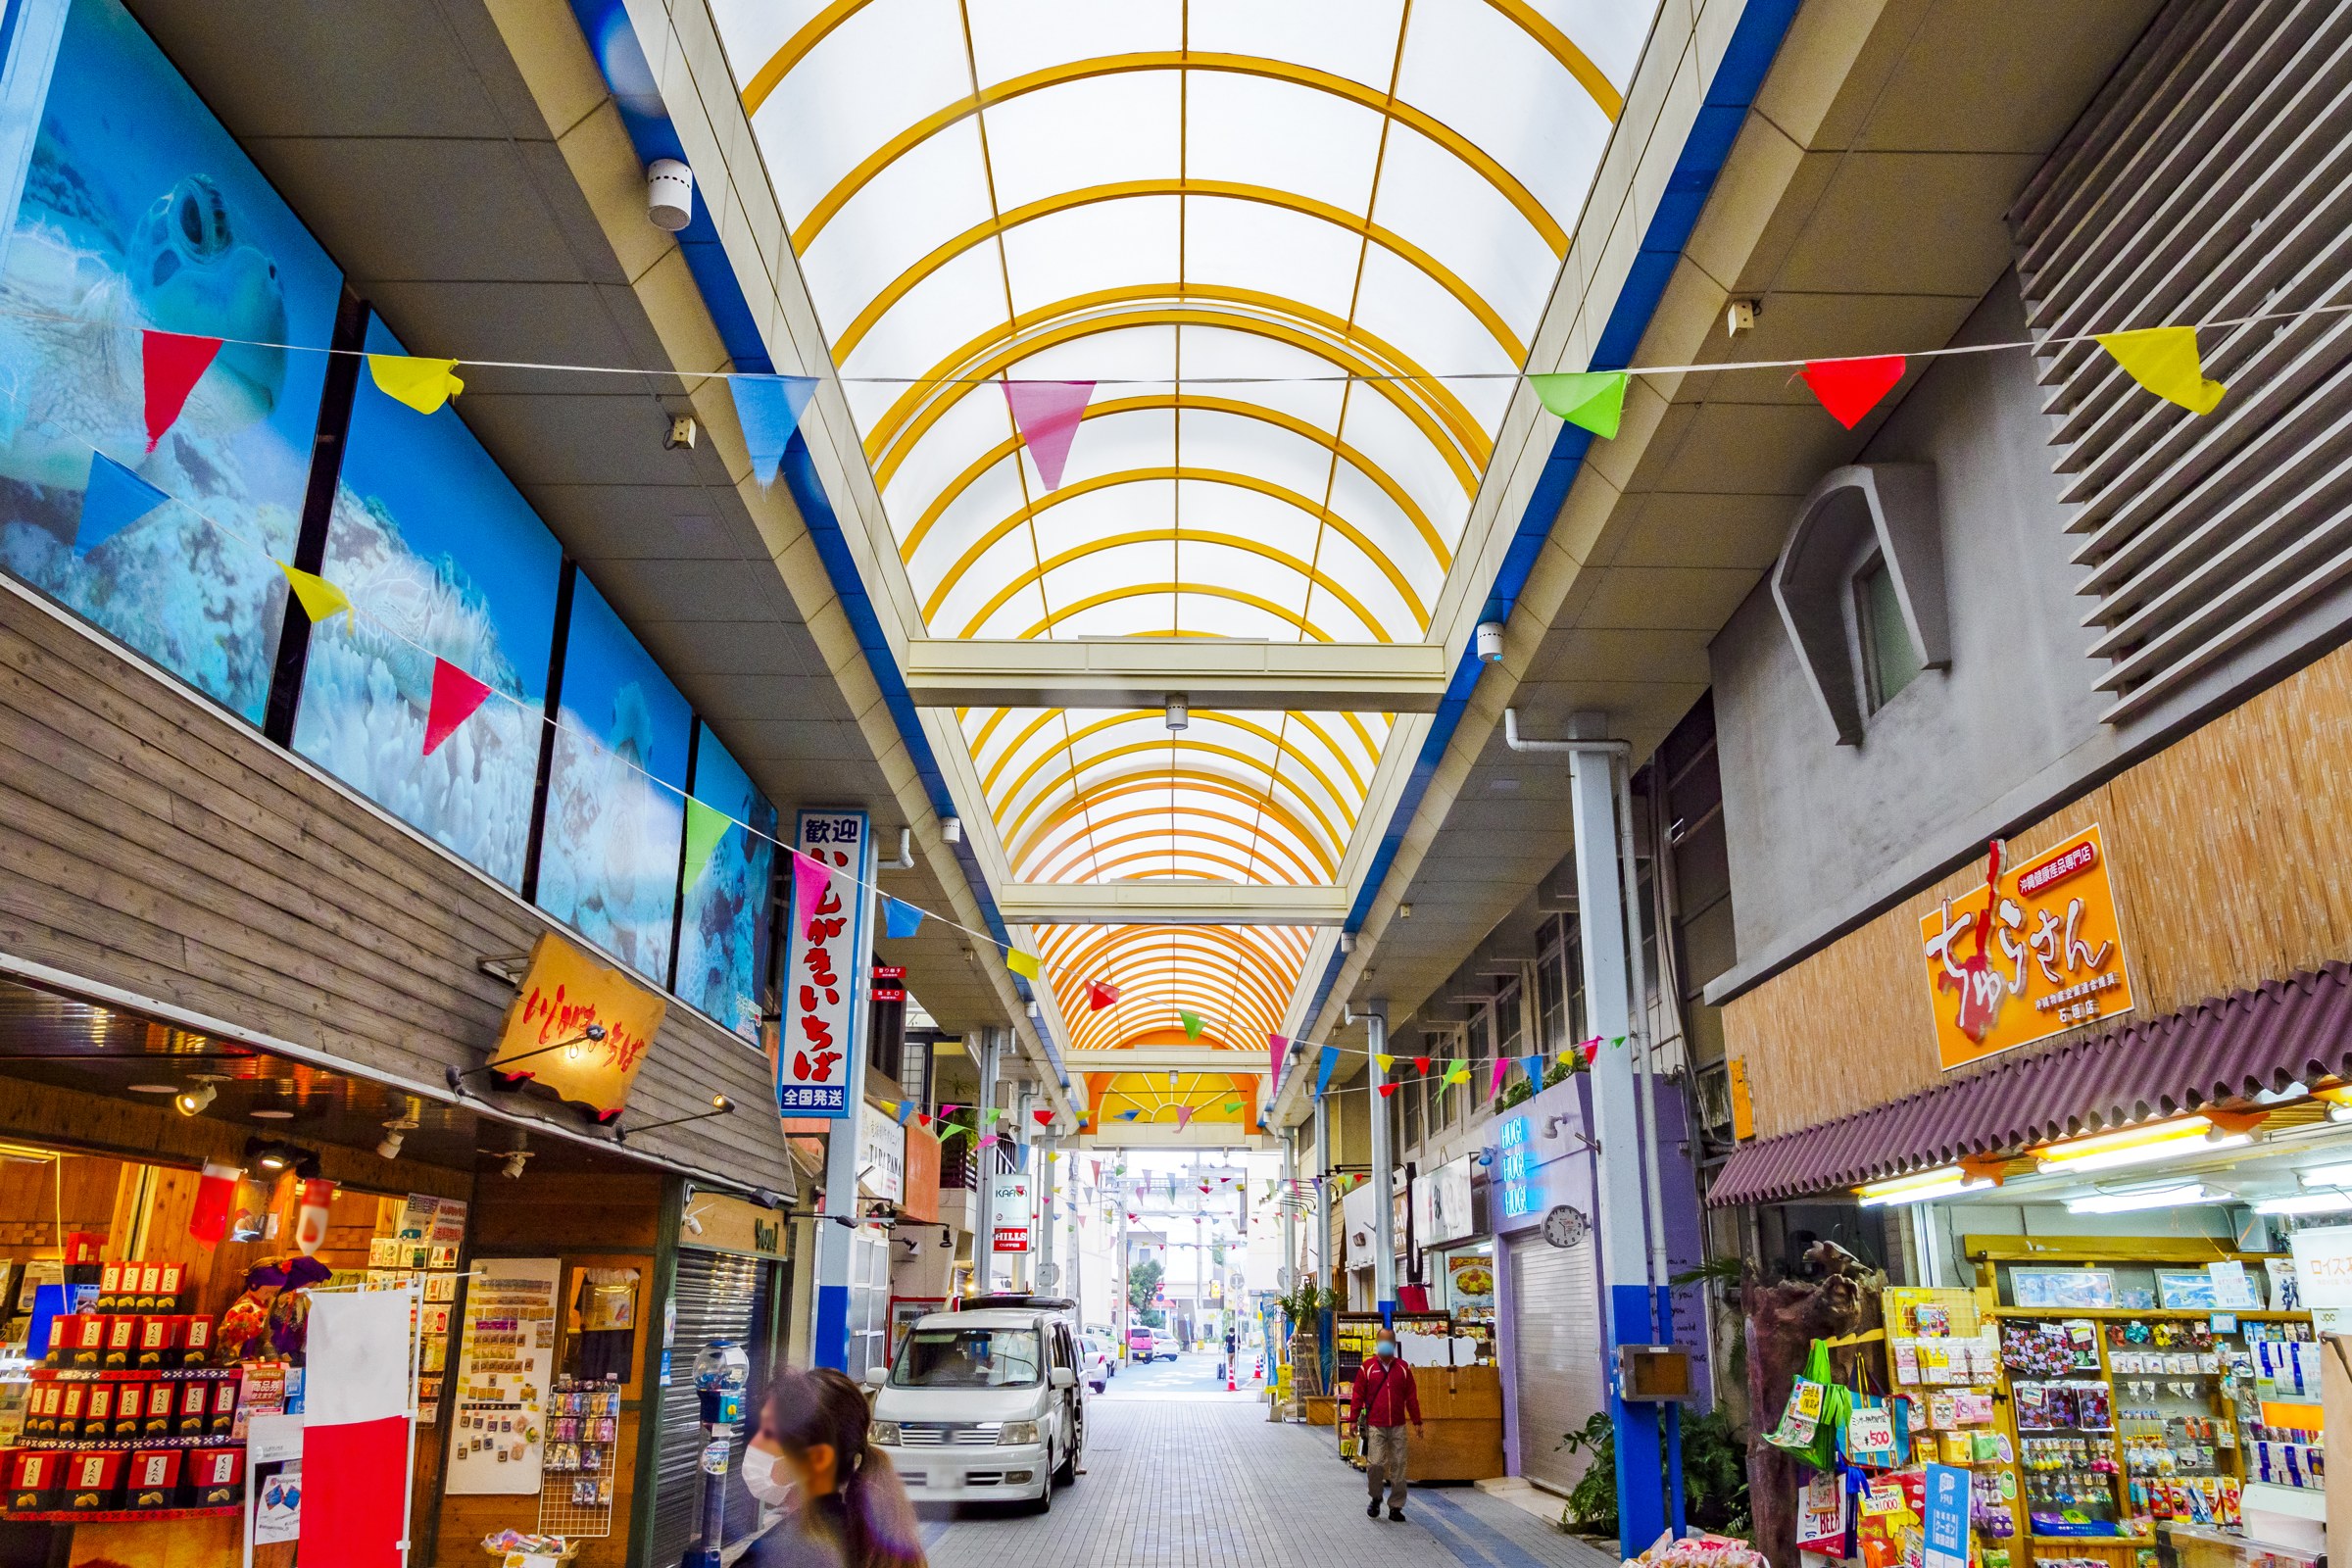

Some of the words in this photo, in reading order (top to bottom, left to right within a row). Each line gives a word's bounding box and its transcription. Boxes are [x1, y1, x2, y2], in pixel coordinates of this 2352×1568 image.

[806, 819, 858, 844] 歓迎
[1926, 898, 2109, 1027] ちゅらさん
[783, 1089, 843, 1110] 全国発送
[995, 1232, 1027, 1241] HILLS
[252, 1380, 280, 1393] 商品券
[1864, 1430, 1889, 1446] ¥500
[1936, 1520, 1956, 1535] クーポン
